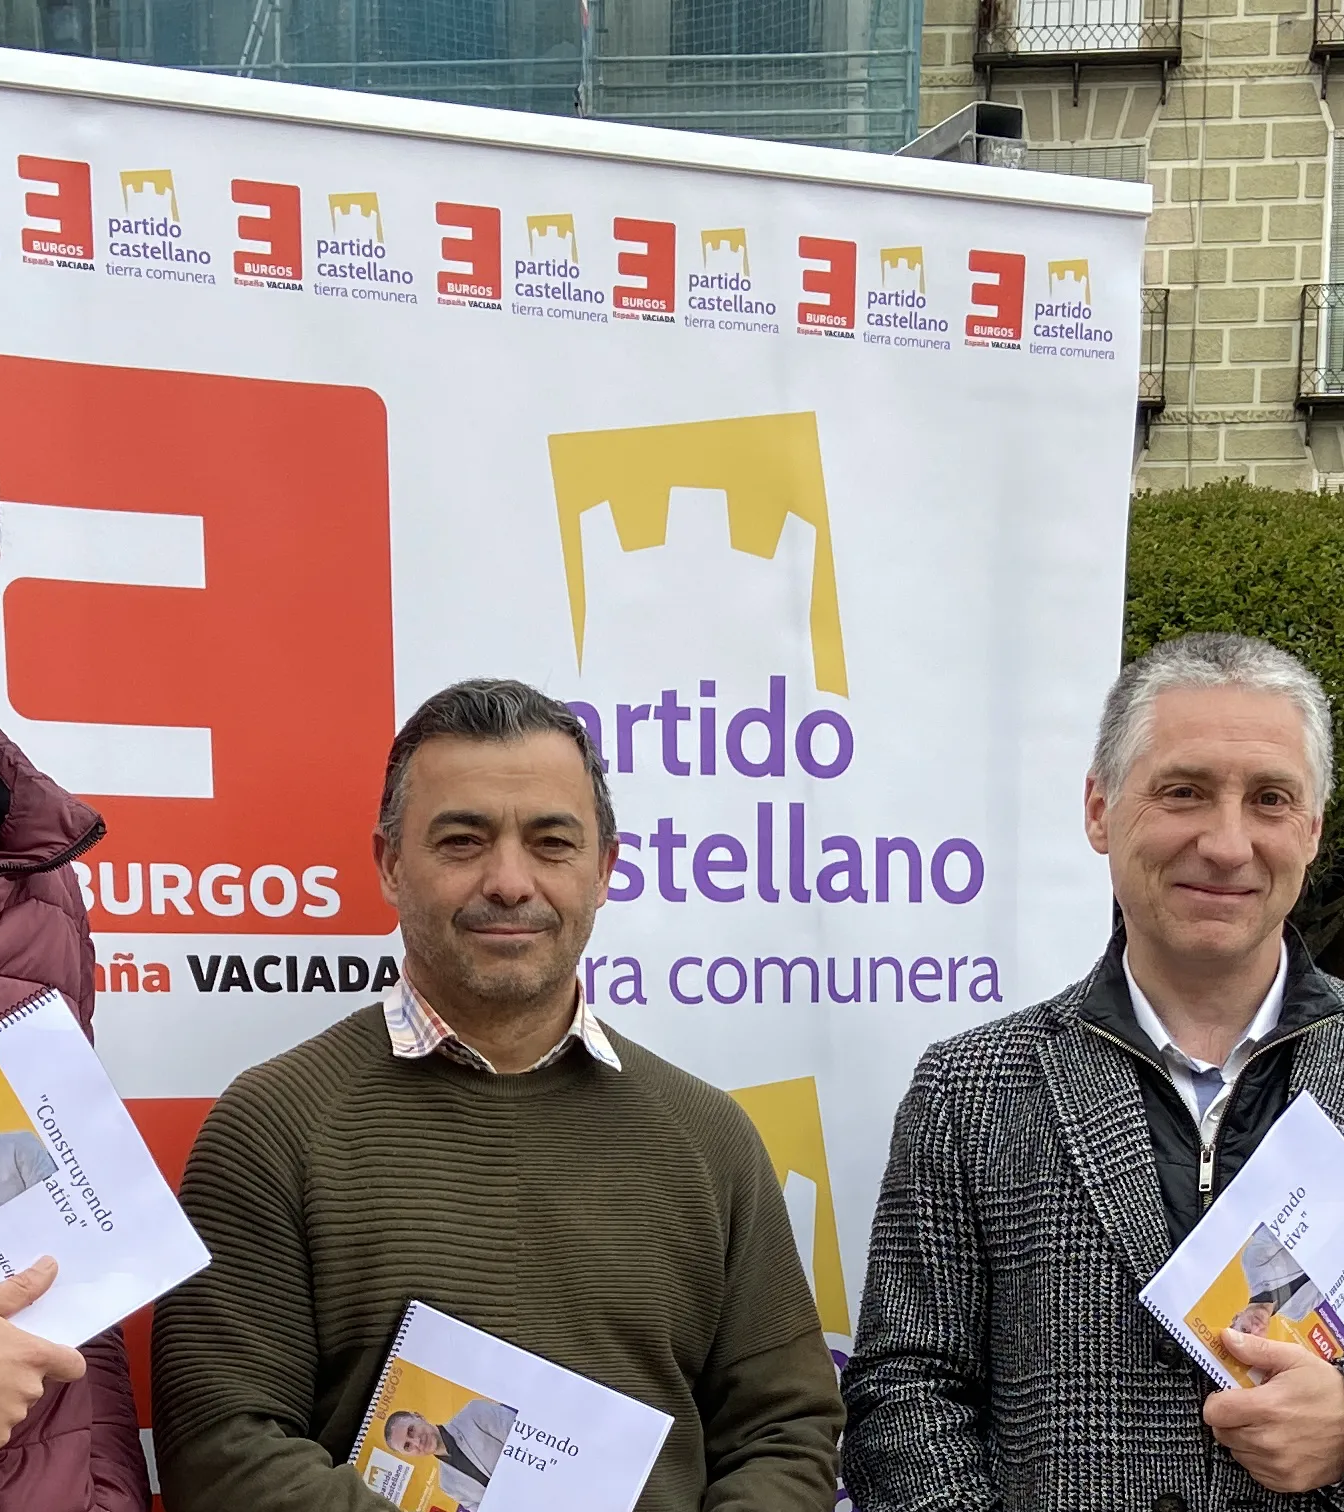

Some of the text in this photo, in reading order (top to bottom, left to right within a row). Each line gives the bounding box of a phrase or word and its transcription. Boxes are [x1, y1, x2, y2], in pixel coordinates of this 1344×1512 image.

[109, 217, 182, 238] partido
[33, 240, 83, 256] BURGOS
[109, 241, 211, 264] castellano
[317, 239, 386, 259] partido
[56, 259, 95, 271] VACIADA
[106, 262, 216, 284] tierra comunera
[244, 262, 292, 277] BURGOS
[317, 262, 413, 284] castellano
[515, 259, 580, 279] partido
[267, 281, 303, 291] VACIADA
[447, 282, 493, 296] BURGOS
[689, 273, 751, 292] partido
[314, 282, 418, 304] tierra comunera
[515, 282, 604, 304] castellano
[868, 290, 926, 309] partido
[468, 300, 502, 311] VACIADA
[512, 302, 608, 323] tierra comunera
[622, 297, 667, 310] BURGOS
[688, 295, 776, 315] castellano
[1035, 301, 1092, 320] partido
[642, 313, 675, 324] VACIADA
[685, 315, 779, 334] tierra comunera
[806, 313, 847, 326] BURGOS
[867, 311, 948, 332] castellano
[824, 330, 855, 339] VACIADA
[863, 332, 951, 350] tierra comunera
[974, 325, 1013, 338] BURGOS
[1034, 324, 1113, 342] castellano
[991, 341, 1021, 350] VACIADA
[1029, 342, 1115, 360] tierra comunera
[563, 676, 853, 778] artido
[606, 802, 984, 905] stellano
[187, 954, 400, 993] VACIADA
[669, 955, 1003, 1005] comunera
[35, 1094, 114, 1232] "Construyendo
[1270, 1186, 1306, 1237] yendo
[1284, 1211, 1309, 1250] tiva"
[1312, 1327, 1333, 1360] VOTA
[375, 1366, 404, 1421] BURGOS
[503, 1443, 558, 1473] ativa"
